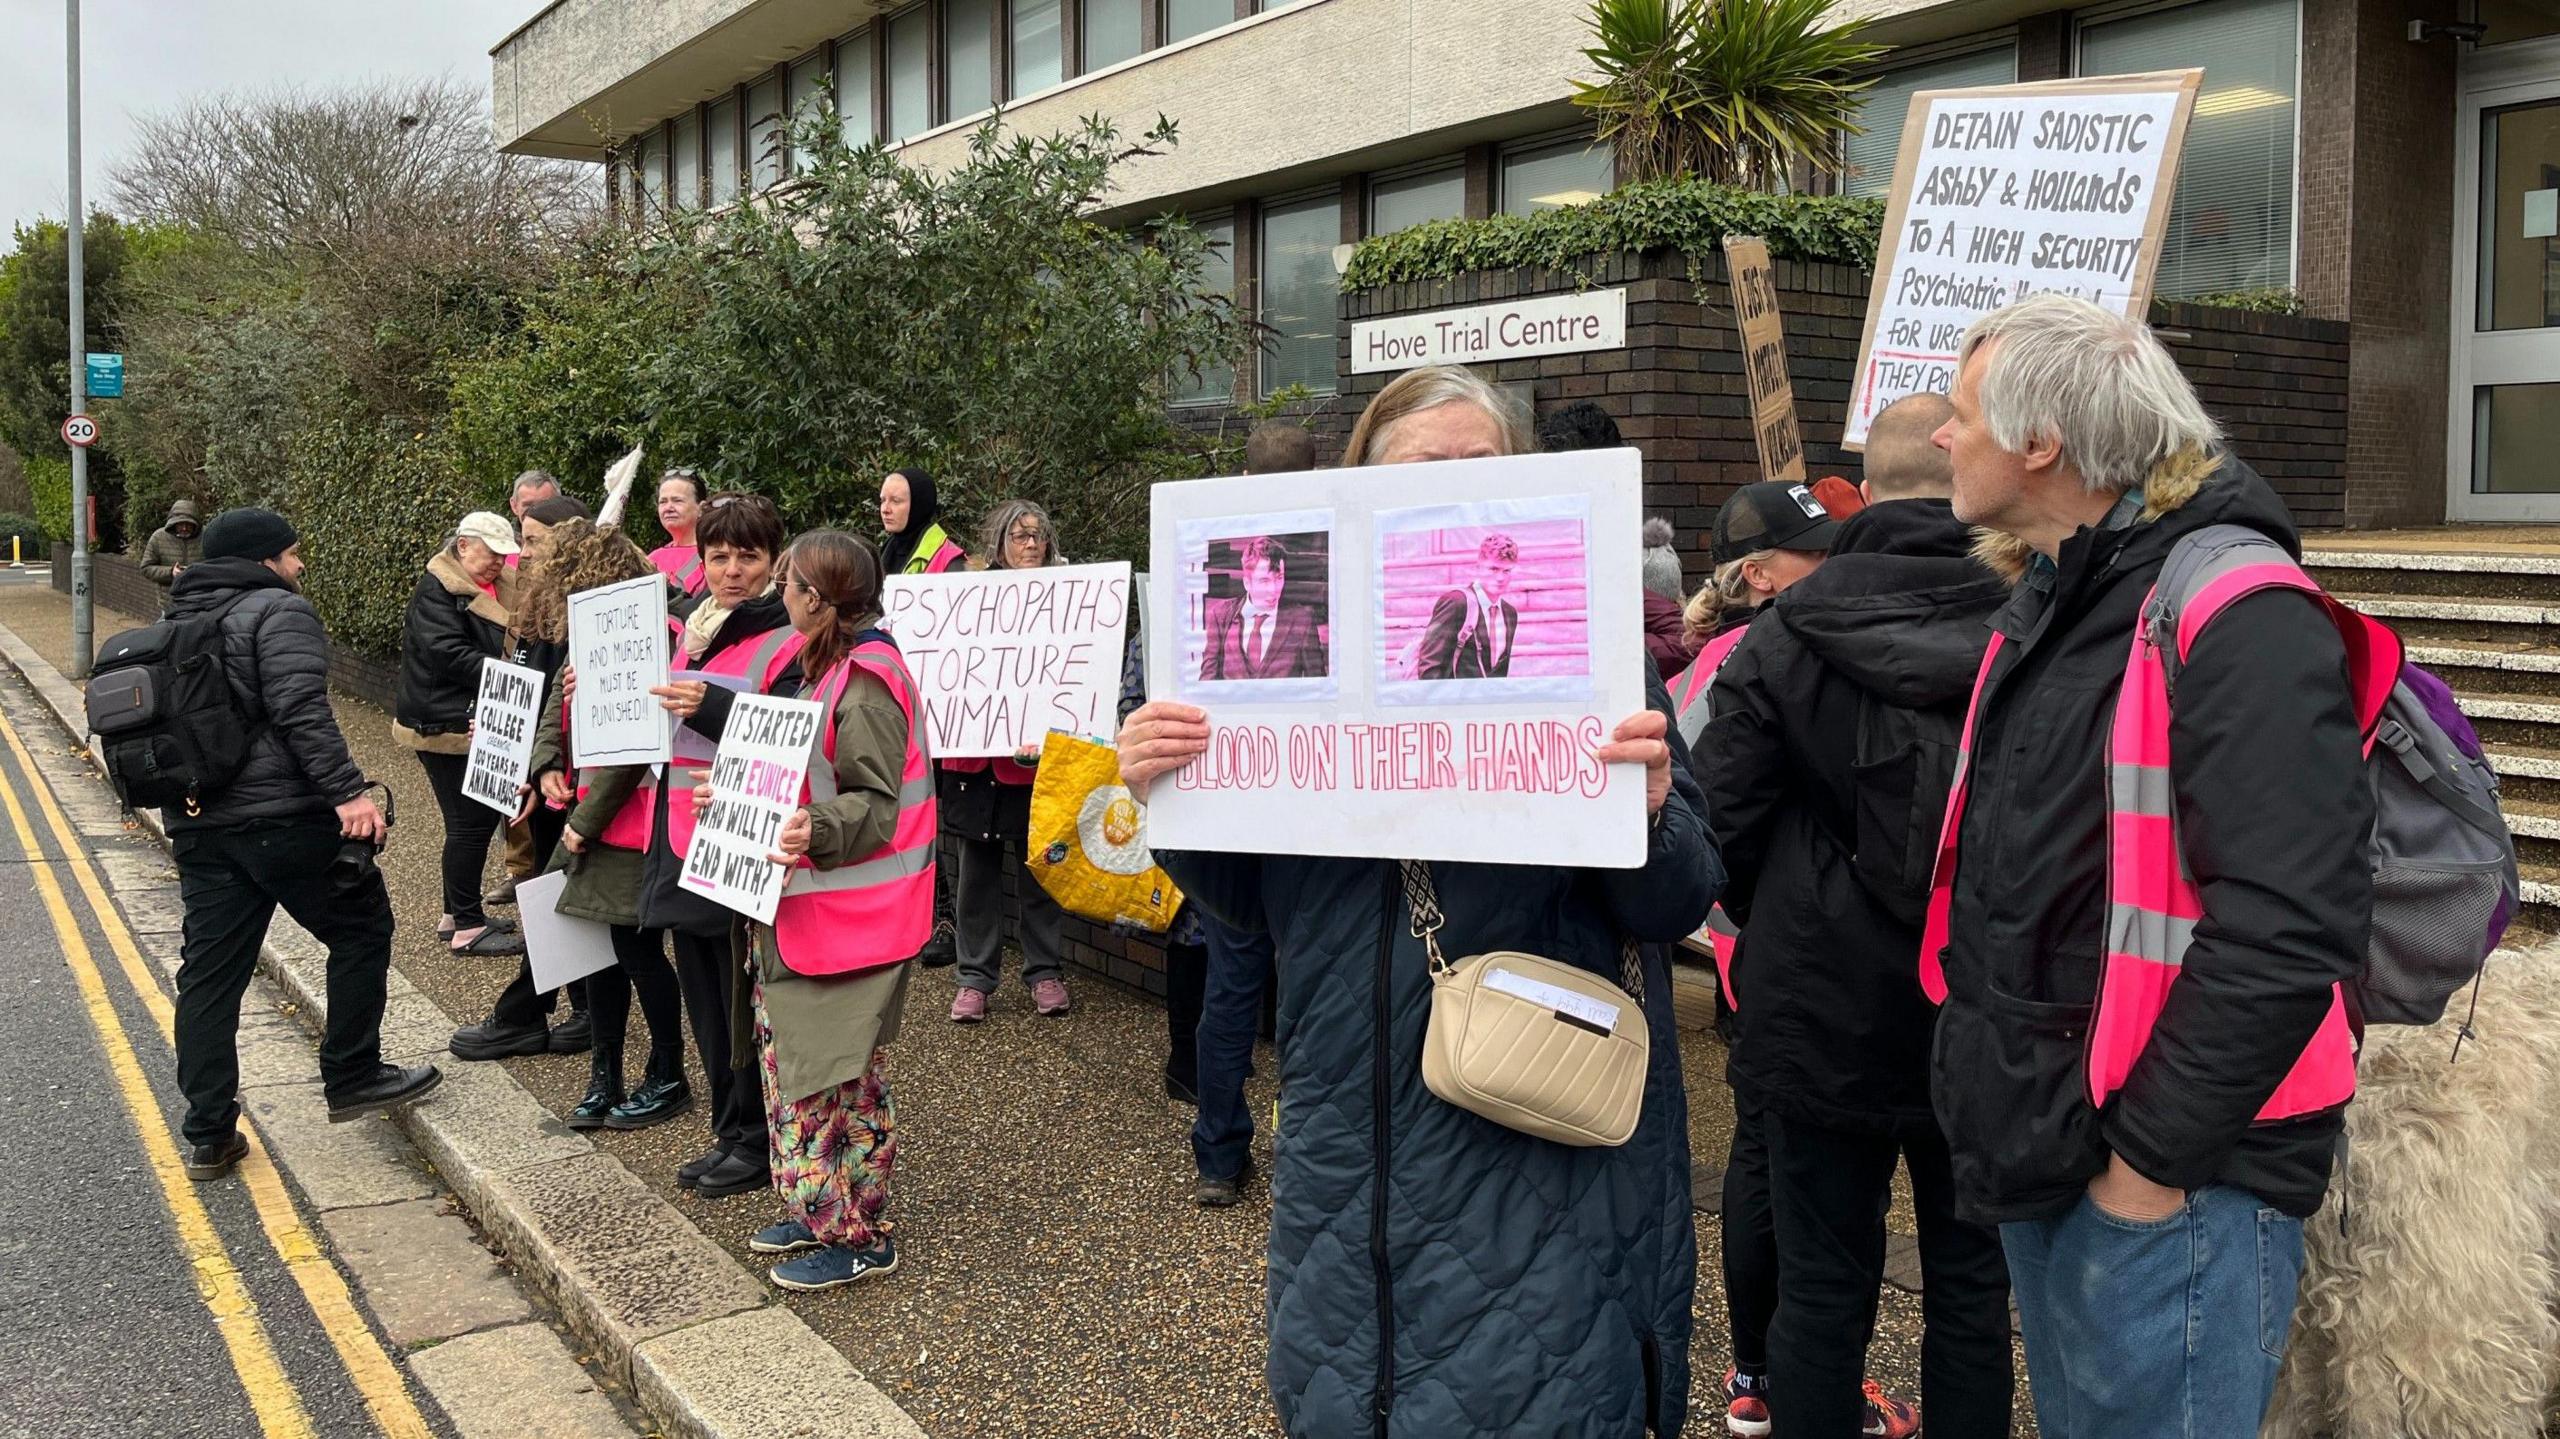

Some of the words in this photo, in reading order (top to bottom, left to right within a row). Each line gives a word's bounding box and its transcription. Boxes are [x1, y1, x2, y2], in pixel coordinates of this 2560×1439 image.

[1932, 111, 2024, 150] DETAIN
[2033, 110, 2154, 153] SADISTIC
[1999, 172, 2019, 206] &
[1936, 220, 1955, 257] A
[1966, 226, 2025, 266] HIGH
[2031, 232, 2144, 282] SECURITY
[1369, 329, 1426, 362] Hove
[1435, 316, 1490, 354] Trial
[1499, 312, 1600, 347] Centre
[1929, 324, 1965, 350] URG
[1879, 361, 1927, 392] THEY
[69, 423, 94, 437] 20
[595, 603, 639, 636] TORTURE
[890, 579, 1126, 640] PSYCHOPATHS
[589, 646, 608, 671] AND
[613, 636, 653, 664] MURDER
[907, 644, 1093, 692] TORTURE
[482, 667, 534, 710] PLUMPTON
[600, 672, 622, 694] MUST
[626, 670, 638, 691] BE
[480, 706, 525, 743] COLLEGE
[591, 696, 649, 729] PUNISHED!!
[726, 702, 750, 738] IT
[742, 705, 814, 748] STARTED
[924, 692, 1097, 750] NIMALS!
[486, 752, 509, 775] YEARS
[510, 761, 519, 777] OF
[712, 753, 748, 792] WITH
[745, 759, 798, 805] EUNICE
[1289, 724, 1336, 791] ON
[1344, 721, 1457, 791] THEIR
[1466, 716, 1608, 799] HANDS
[468, 766, 497, 799] ANIMAL
[496, 777, 519, 810] ABUSE
[699, 799, 727, 830] WHO
[726, 801, 759, 841] WILL
[760, 810, 781, 847] IT
[690, 838, 721, 879] END
[723, 852, 773, 911] WITH?
